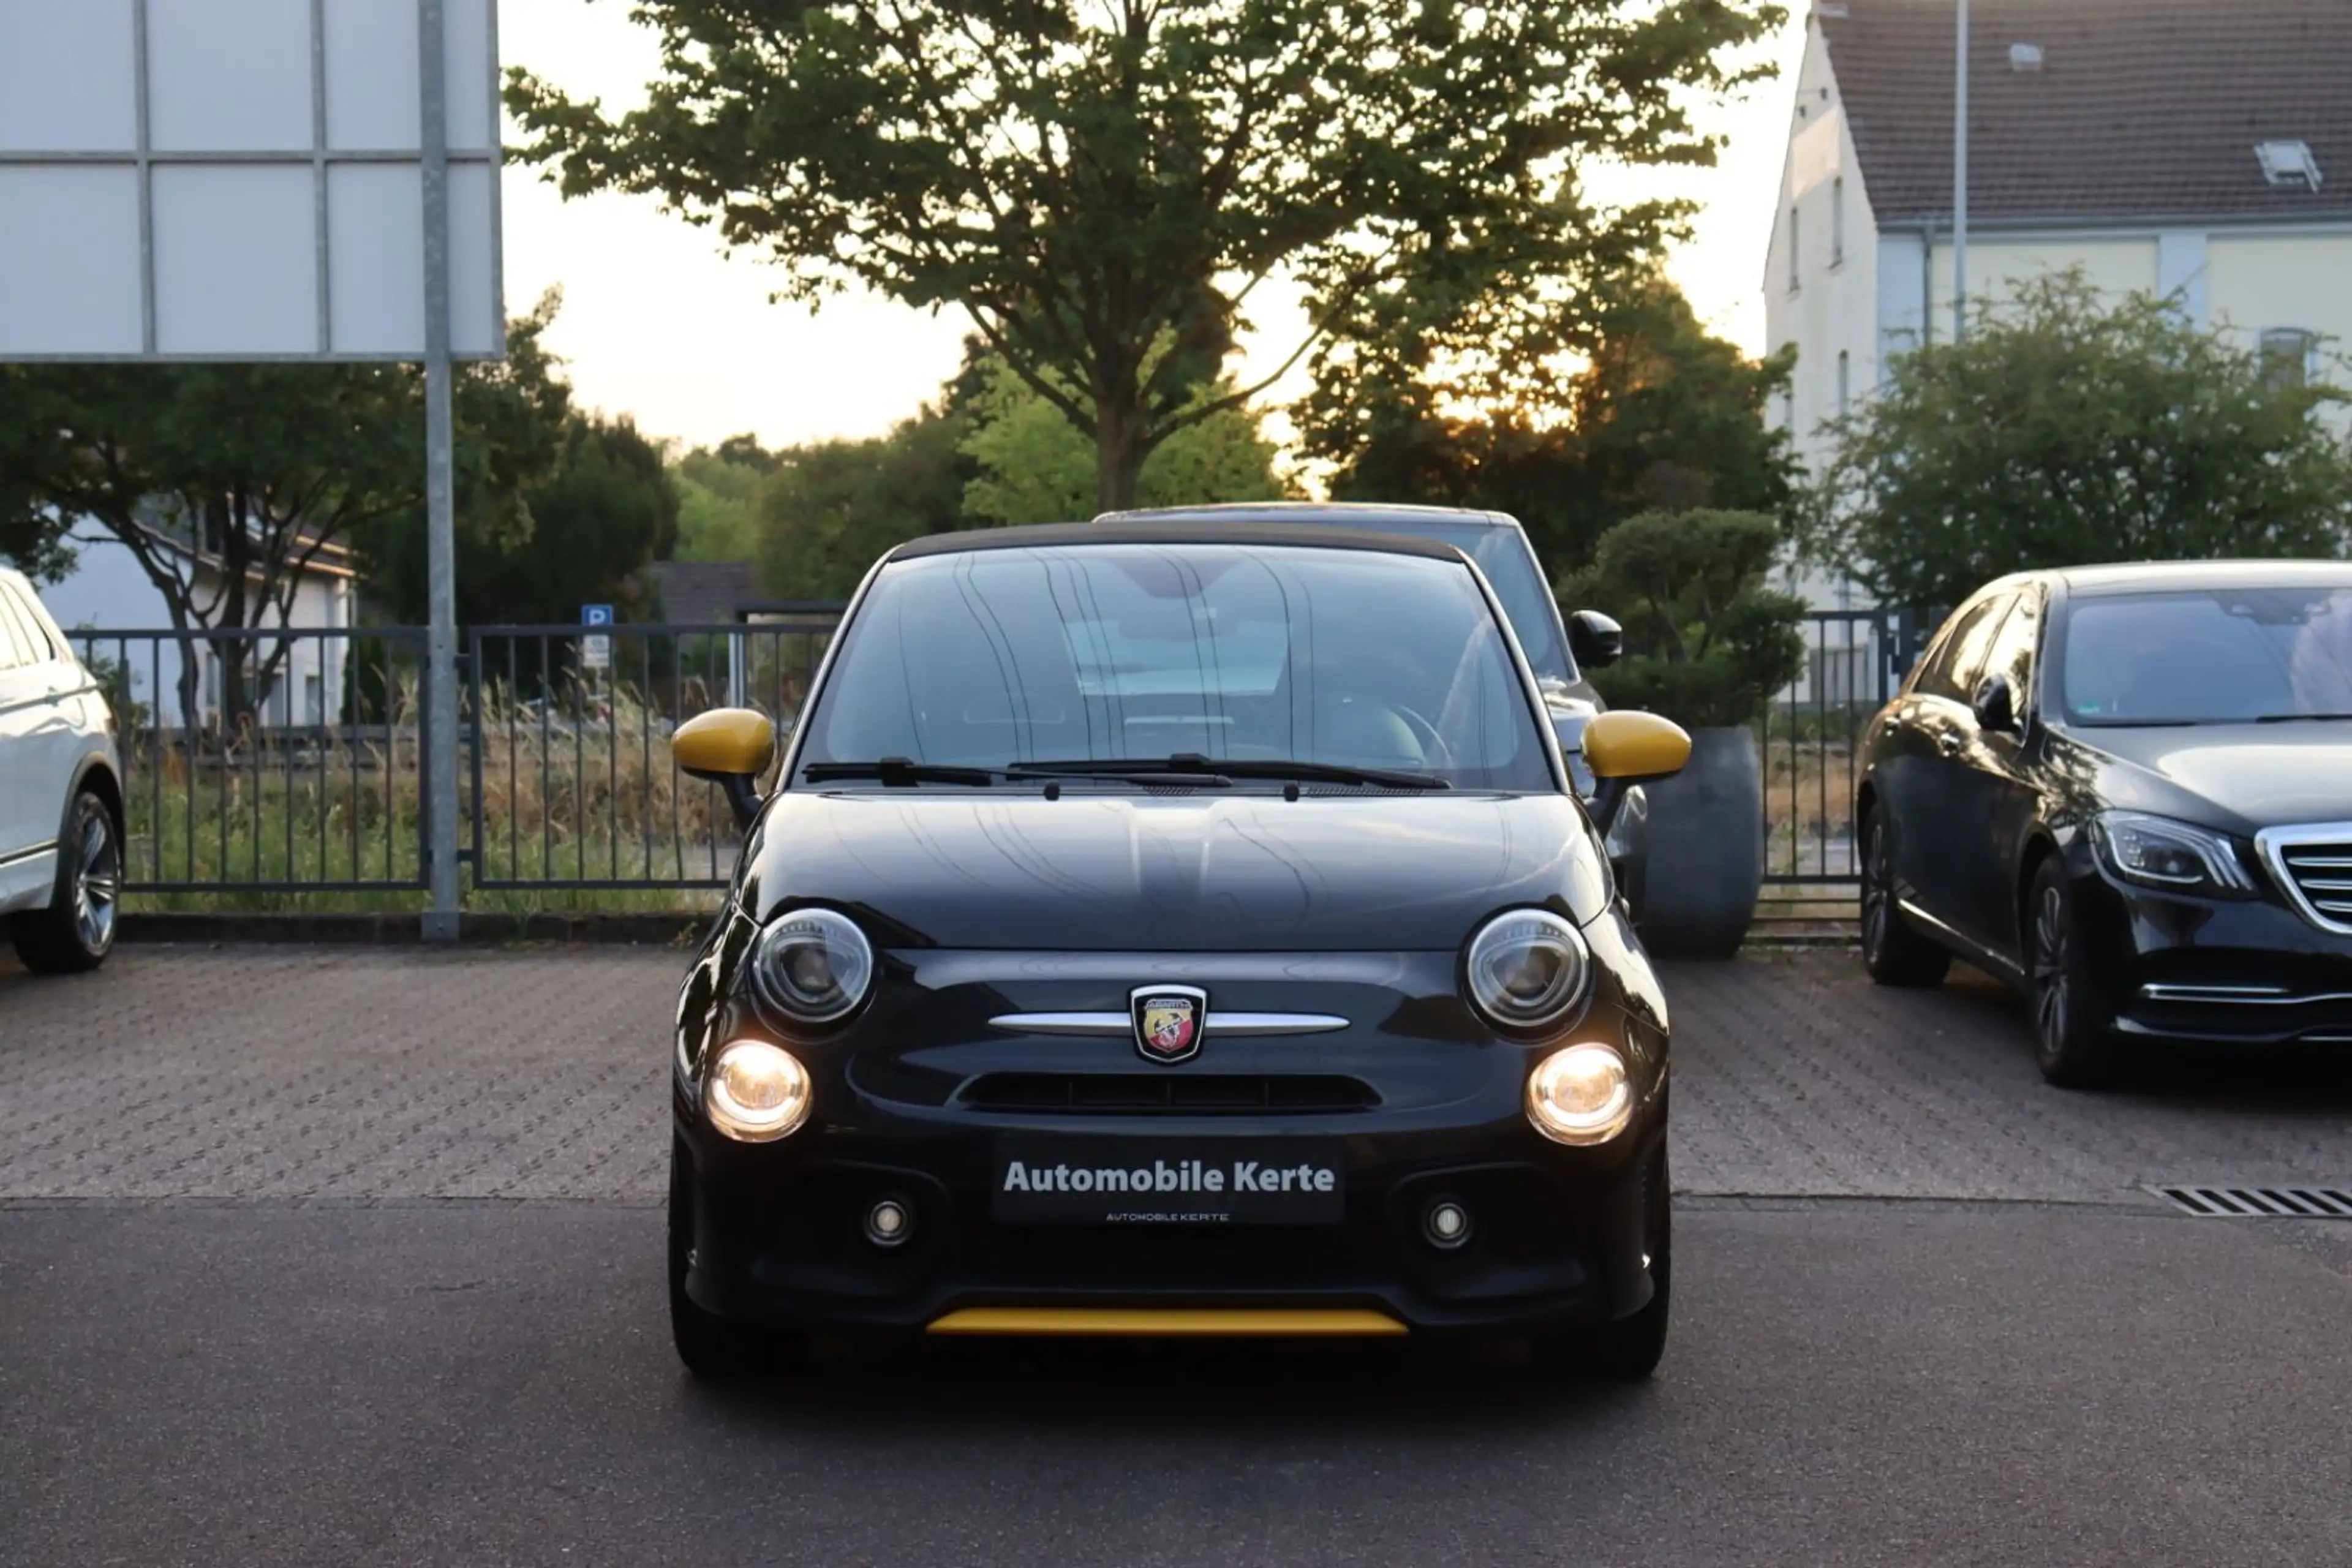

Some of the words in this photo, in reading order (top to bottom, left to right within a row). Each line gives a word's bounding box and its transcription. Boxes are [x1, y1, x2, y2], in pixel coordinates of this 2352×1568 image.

[589, 609, 606, 626] P
[1003, 1160, 1224, 1192] Automobile
[1234, 1161, 1335, 1192] Kerte
[1180, 1213, 1230, 1222] KERTE
